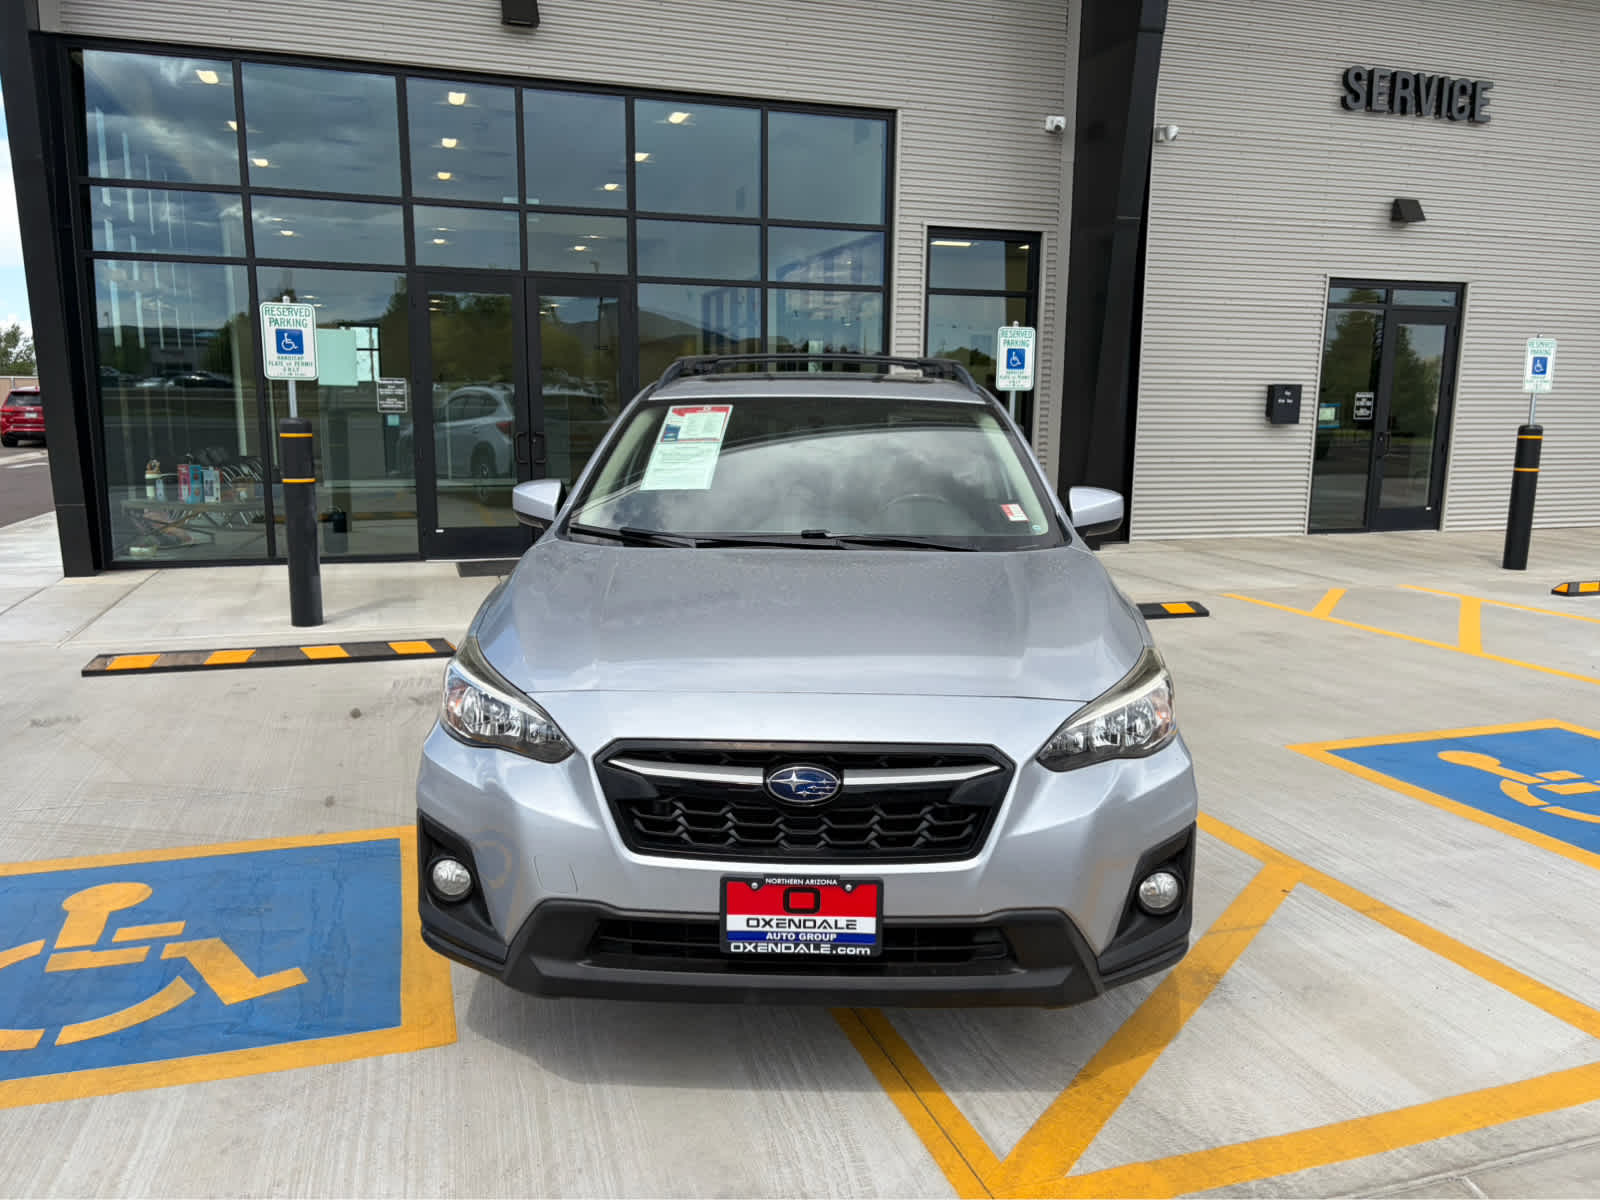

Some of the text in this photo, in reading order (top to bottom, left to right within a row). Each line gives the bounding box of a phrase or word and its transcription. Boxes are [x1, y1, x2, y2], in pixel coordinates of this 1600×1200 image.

[1340, 65, 1494, 123] SERVICE
[264, 306, 311, 317] RESERVED
[268, 317, 308, 328] PARKING
[1001, 330, 1032, 338] RESERVED
[1003, 339, 1030, 347] PARKING
[805, 878, 838, 886] ARIZONA
[746, 917, 857, 930] OXENDALE
[766, 932, 837, 941] AUTO GROUP
[730, 942, 871, 955] OXENDALE.com
